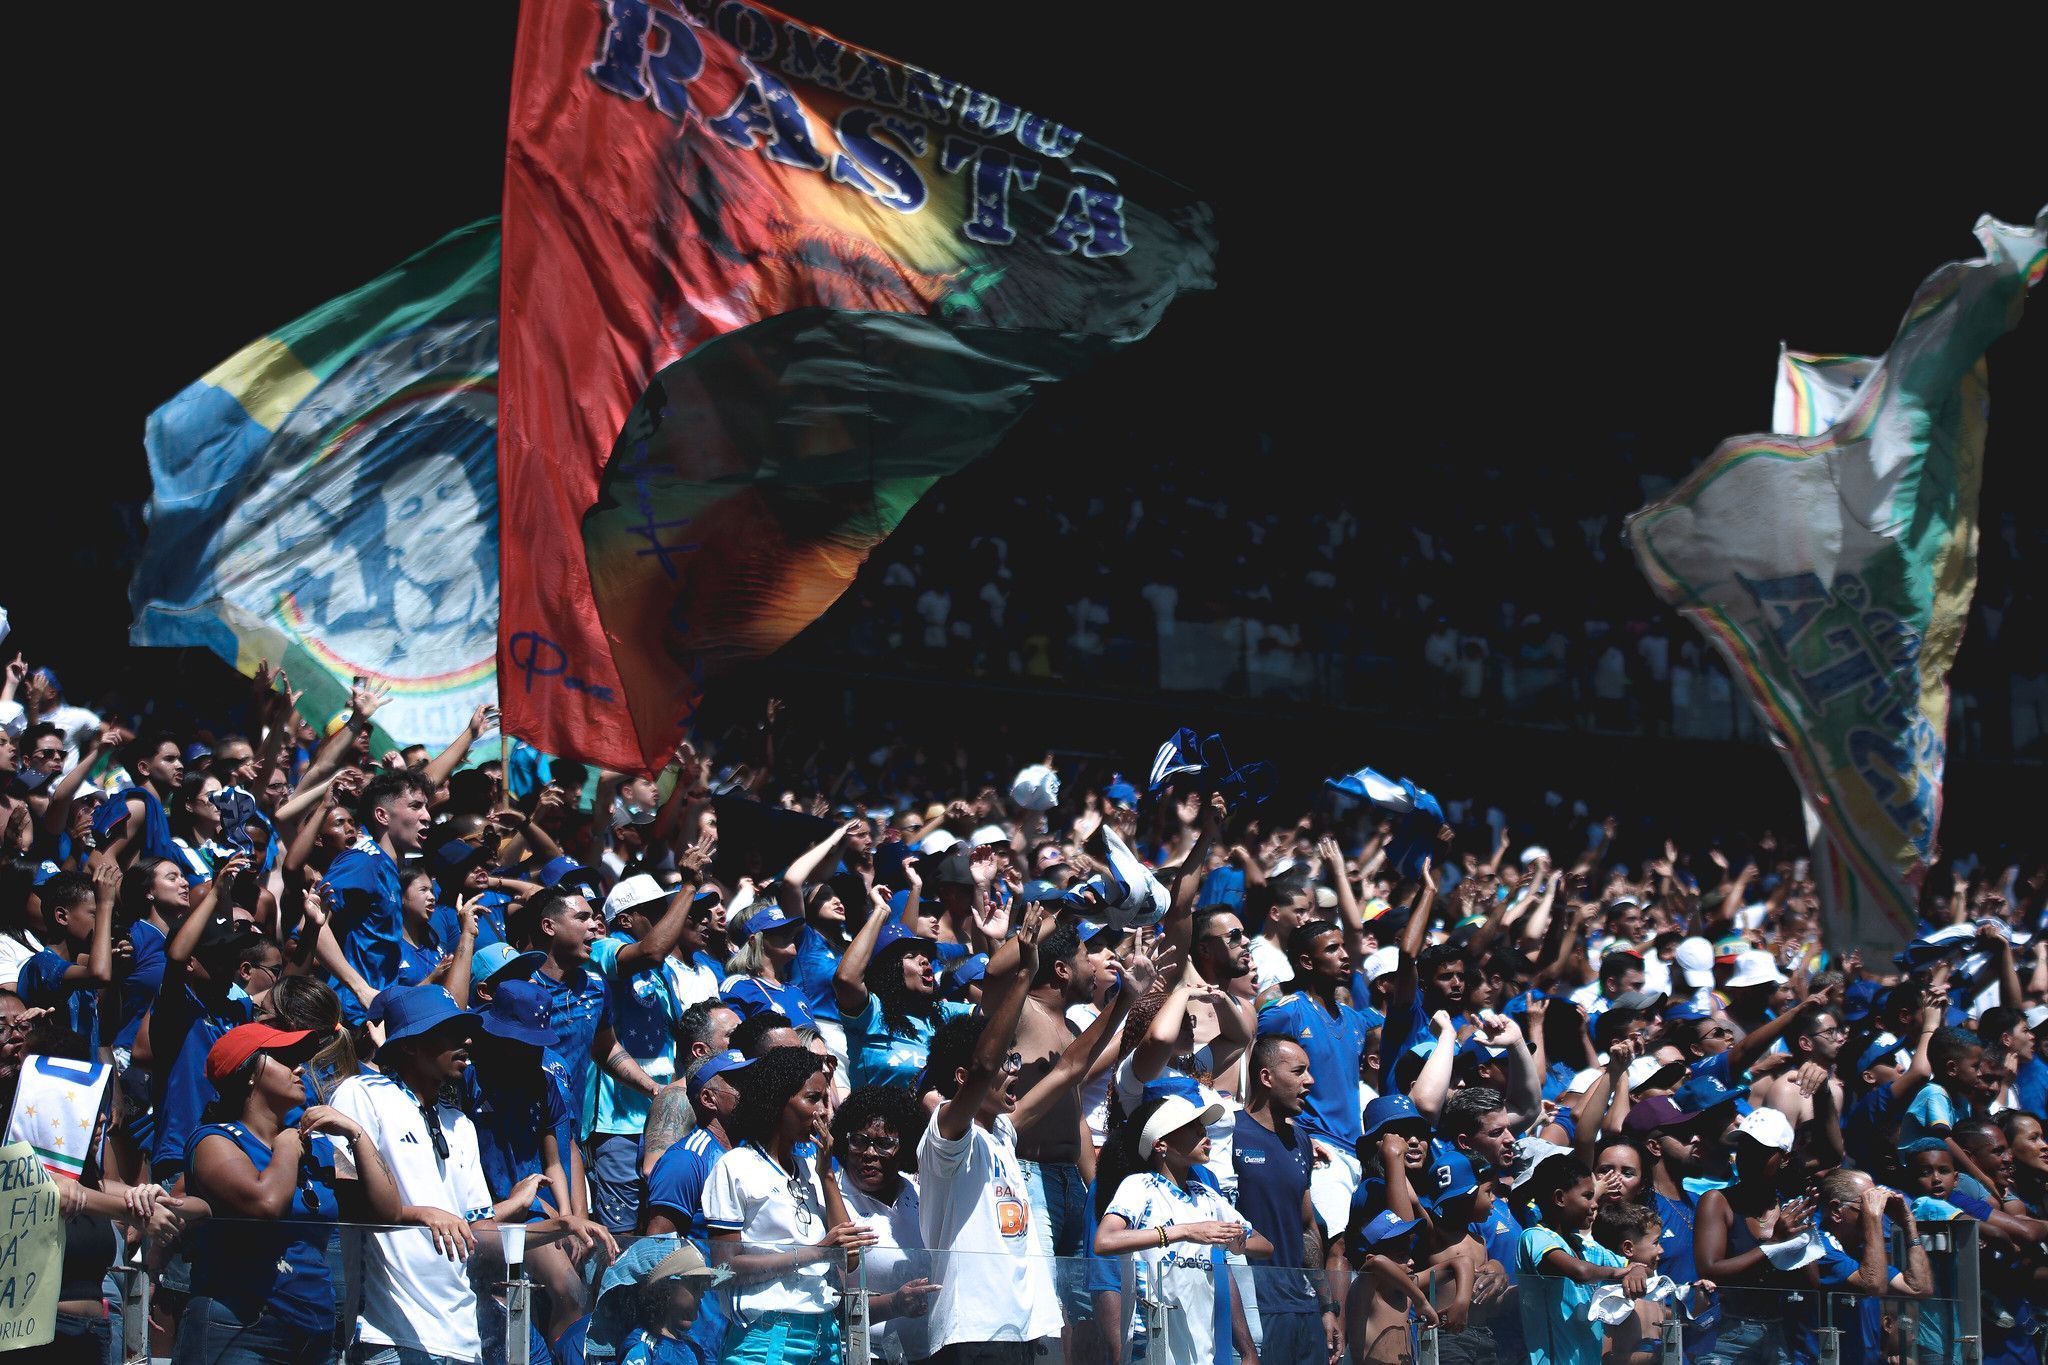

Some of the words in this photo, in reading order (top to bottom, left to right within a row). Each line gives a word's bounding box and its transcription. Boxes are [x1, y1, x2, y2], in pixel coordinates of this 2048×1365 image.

[676, 0, 1083, 158] OMANDO
[588, 0, 1133, 258] RASTA
[1437, 1165, 1452, 1188] 3
[0, 1317, 36, 1341] RILO
